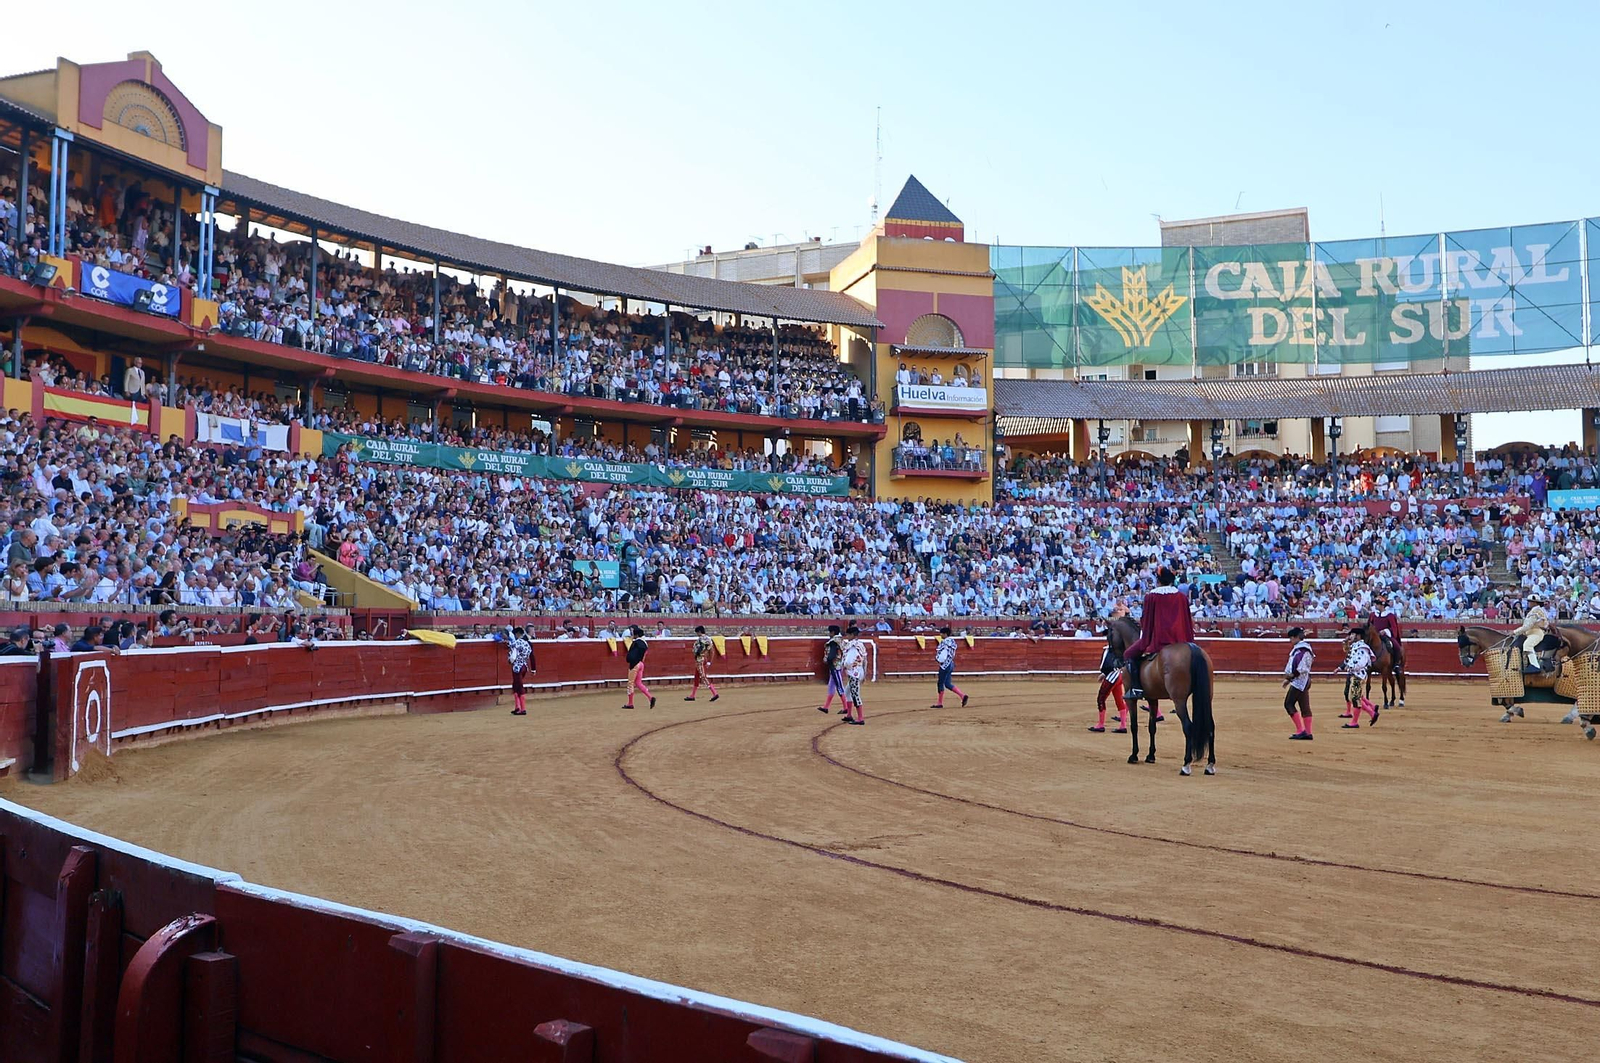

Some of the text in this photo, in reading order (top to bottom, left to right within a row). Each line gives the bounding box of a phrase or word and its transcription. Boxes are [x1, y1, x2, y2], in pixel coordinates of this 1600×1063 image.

[1205, 244, 1569, 302] CAJA RURAL
[90, 287, 108, 298] COPE
[150, 303, 167, 313] COPE
[1248, 298, 1523, 346] DEL SUR
[901, 387, 984, 403] Huelva Información
[366, 440, 419, 454] CAJA RURAL
[372, 450, 413, 462] DEL SUR
[477, 453, 528, 465] CAJA RURAL
[484, 462, 522, 474] DEL SUR
[584, 462, 633, 473] CAJA RURAL
[590, 472, 627, 481] DEL SUR
[687, 470, 734, 480] CAJA RURAL
[692, 479, 728, 488] DEL SUR
[786, 477, 833, 486] CAJA RURAL
[791, 485, 808, 493] DEL
